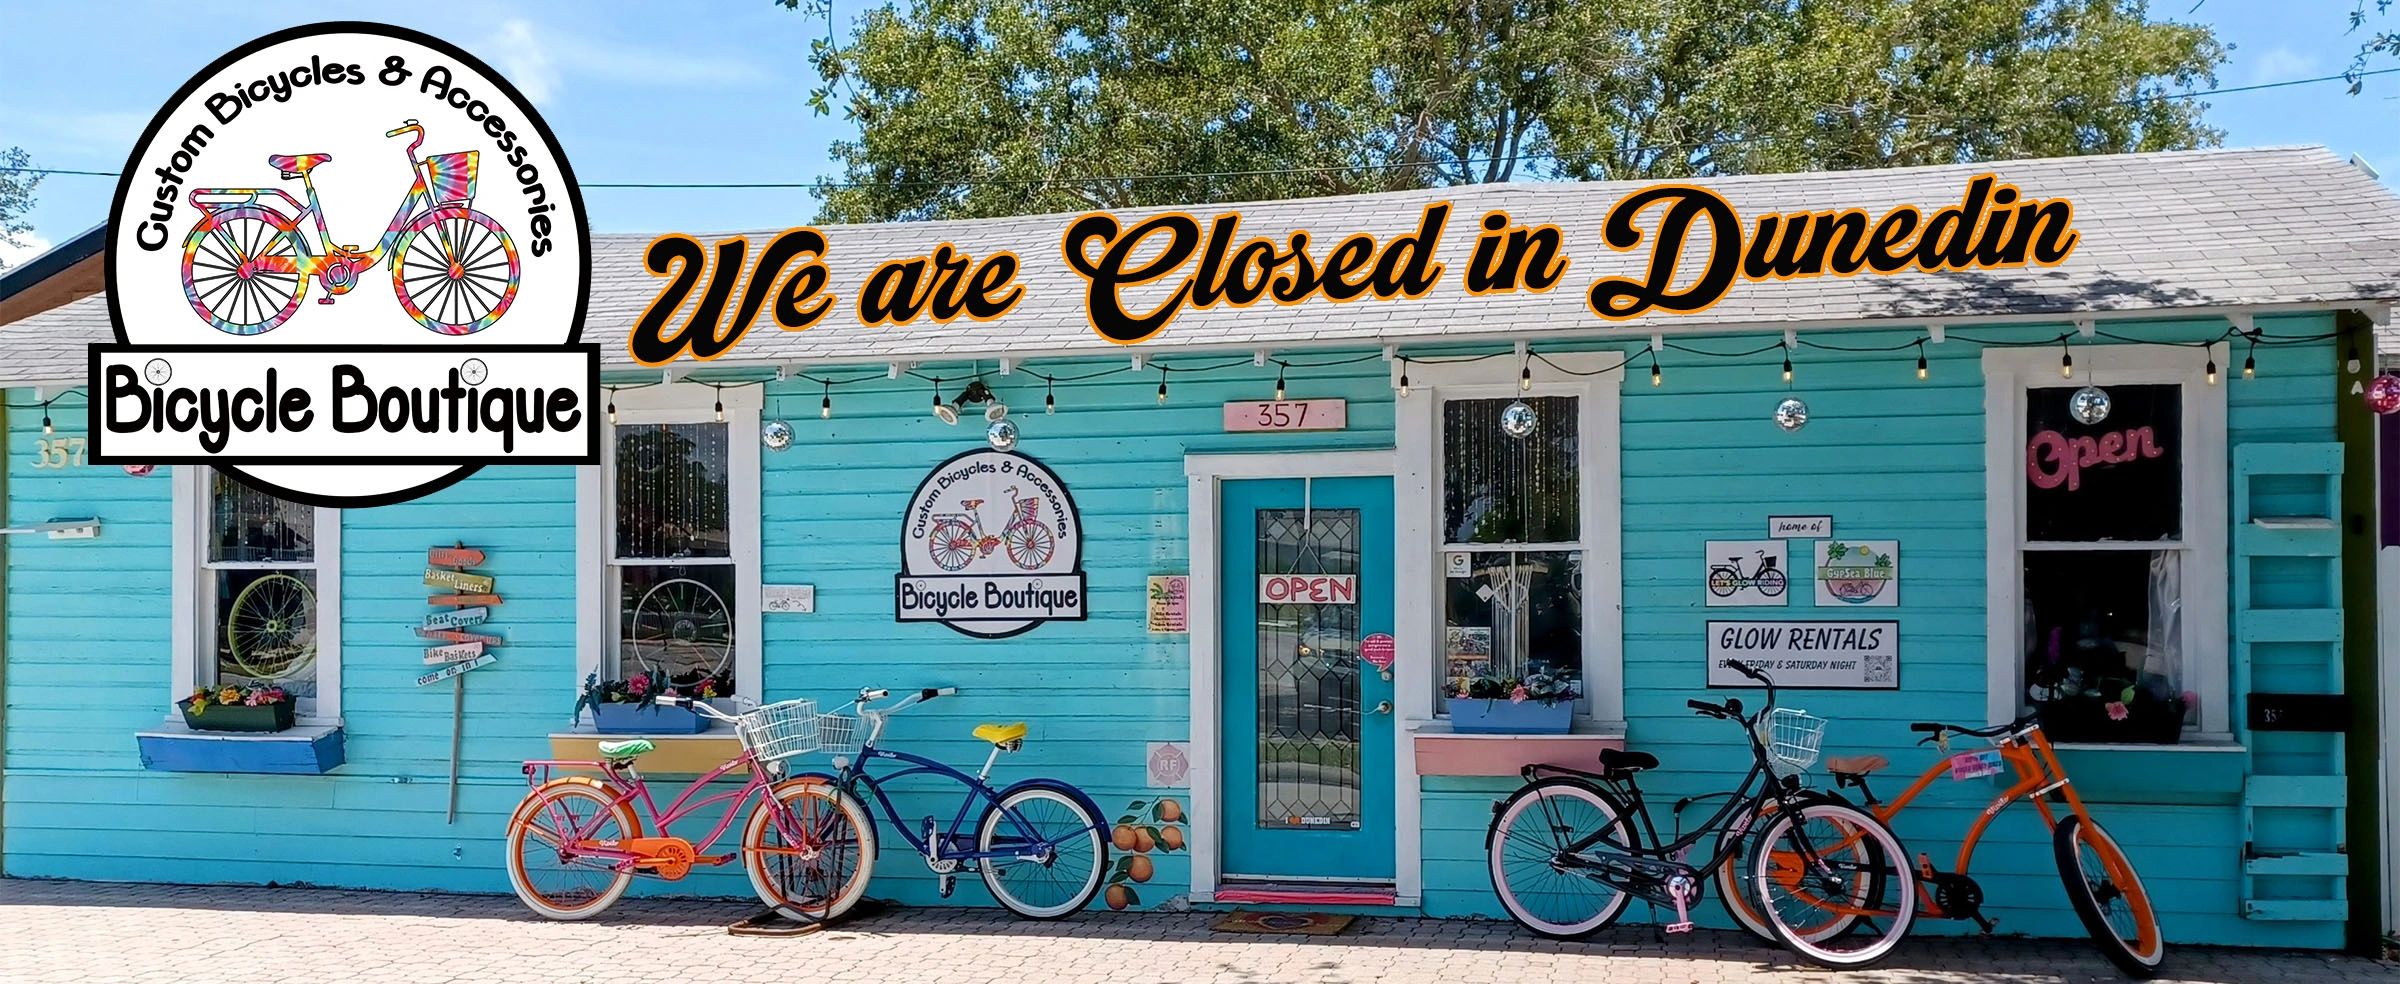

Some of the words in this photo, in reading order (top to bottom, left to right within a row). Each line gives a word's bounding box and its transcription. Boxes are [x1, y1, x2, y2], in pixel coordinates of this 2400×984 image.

[1258, 403, 1308, 427] 357
[32, 437, 86, 468] 357
[2027, 426, 2164, 491] Open
[912, 488, 942, 539] Custom
[937, 461, 996, 490] Bicycles
[1001, 460, 1014, 473] &
[1017, 464, 1068, 540] Accessories
[1778, 521, 1808, 532] home
[1811, 520, 1823, 532] of
[424, 568, 455, 582] Basket
[454, 579, 484, 592] Liners
[1732, 579, 1756, 587] GLOW
[1757, 579, 1784, 587] RIDING
[1826, 567, 1861, 579] GypSea
[1864, 568, 1884, 578] Blue
[902, 580, 979, 617] Bicycle
[985, 580, 1078, 616] Boutique
[1265, 577, 1353, 602] OPEN
[425, 614, 451, 626] Seat
[1720, 628, 1782, 650] GLOW
[1788, 628, 1883, 651] RENTALS
[424, 647, 443, 659] Bike
[1777, 660, 1784, 669] &
[1785, 660, 1828, 669] SATURDAY
[1830, 661, 1857, 670] NIGHT
[417, 672, 439, 685] come
[446, 667, 457, 676] on
[1160, 759, 1177, 771] RF
